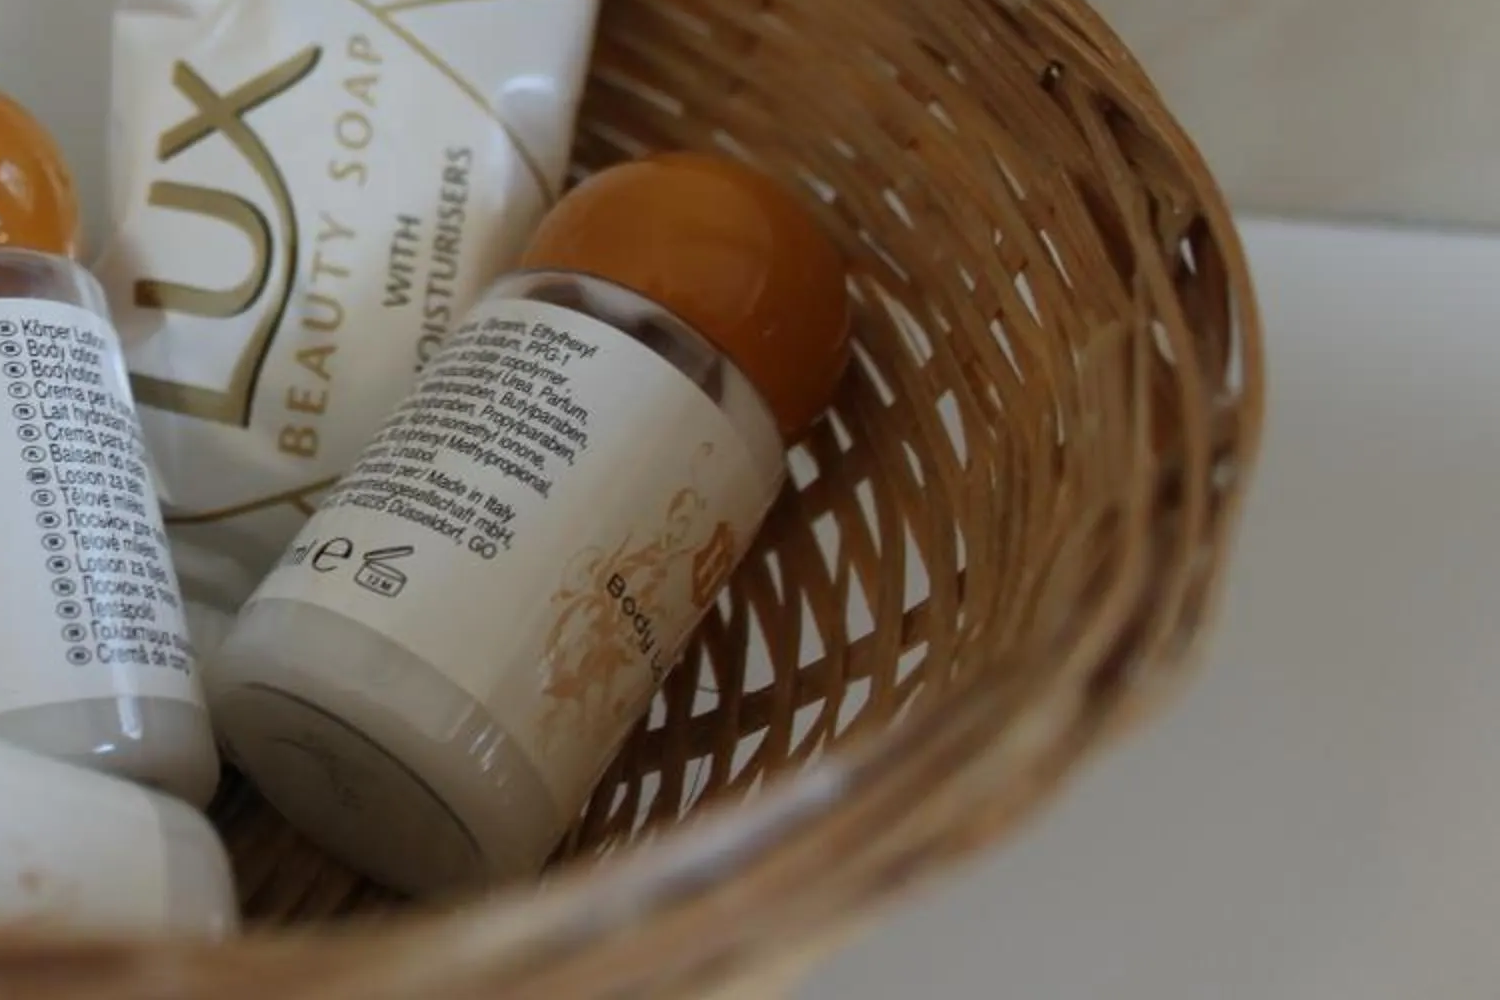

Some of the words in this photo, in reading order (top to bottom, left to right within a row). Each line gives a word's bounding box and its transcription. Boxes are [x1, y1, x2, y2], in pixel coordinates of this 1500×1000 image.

[130, 46, 323, 428] LUX
[278, 211, 356, 458] BEAUTY
[327, 33, 382, 187] SOAP
[382, 214, 421, 308] WITH
[414, 145, 472, 373] OISTURISERS
[21, 319, 70, 339] Körper
[27, 339, 66, 362] Body
[524, 340, 571, 366] PPG-1
[34, 380, 85, 401] Crema
[45, 422, 96, 444] Crema
[425, 471, 468, 496] Made
[467, 487, 484, 505] in
[607, 573, 654, 655] Body
